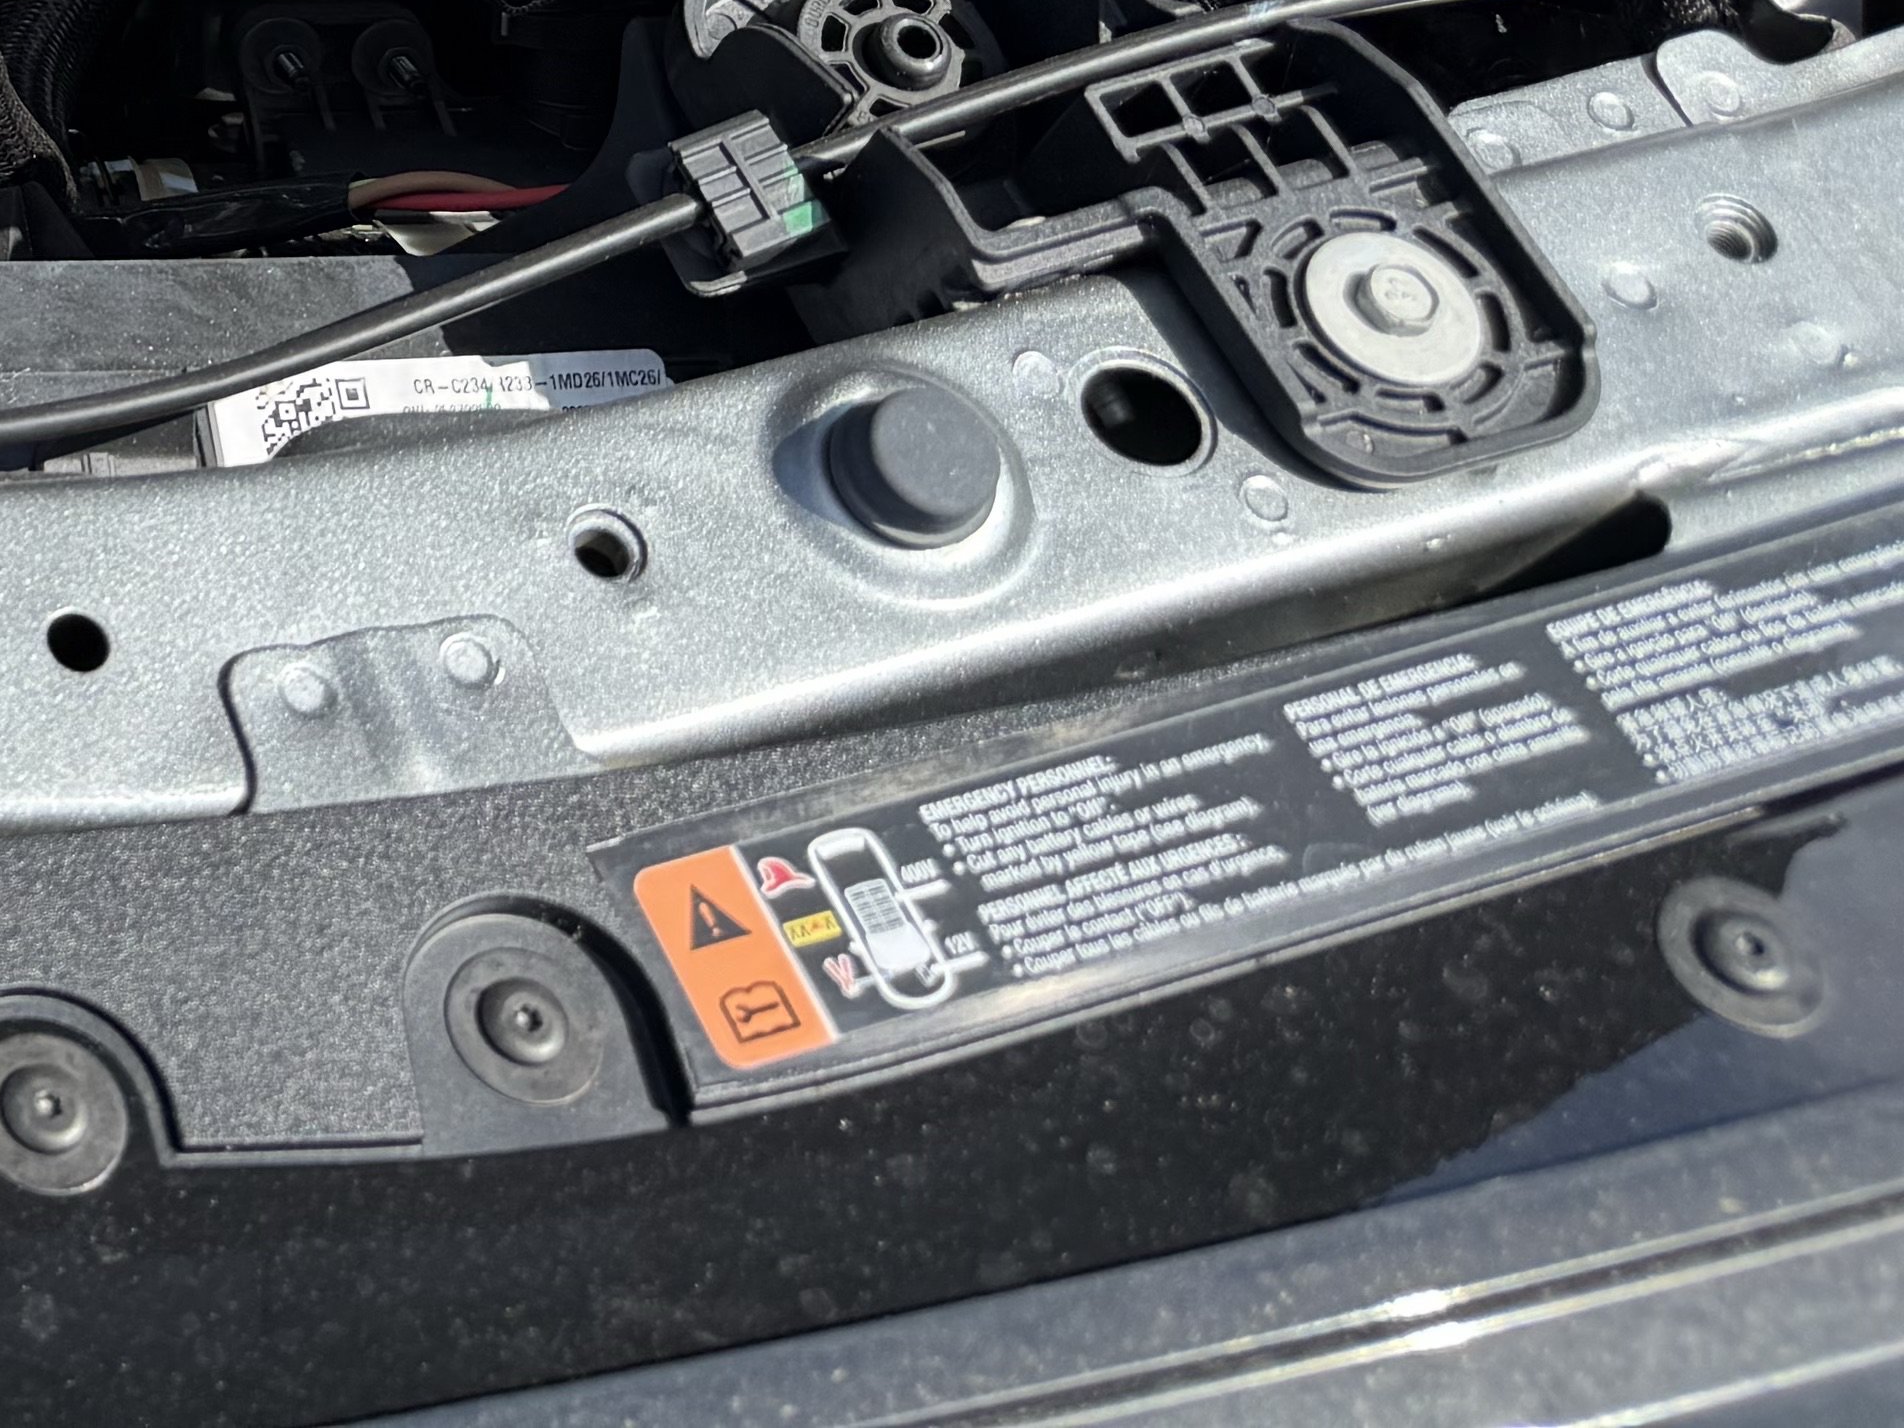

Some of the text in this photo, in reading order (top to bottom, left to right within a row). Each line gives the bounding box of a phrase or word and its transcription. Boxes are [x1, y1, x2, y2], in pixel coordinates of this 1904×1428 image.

[1281, 650, 1481, 722] PERSONAL DE EMERGENCIA:
[916, 753, 1120, 825] EMERGENCY PERSONNEL:
[929, 820, 953, 842] To
[949, 809, 988, 836] help
[985, 797, 1031, 824] avoid
[1029, 779, 1098, 814] personal
[1093, 766, 1143, 797] injury
[1180, 731, 1276, 773] emergency,
[953, 830, 993, 856] Turn
[990, 813, 1053, 846] ignition
[965, 850, 998, 874] Cut
[996, 843, 1028, 868] any
[1025, 826, 1085, 859] battery
[1080, 810, 1136, 840] cables
[1149, 791, 1203, 819] wires
[978, 860, 1043, 893] marked
[1061, 838, 1115, 868] yellow
[1112, 828, 1152, 855] tape
[1147, 816, 1187, 844] (see
[1182, 794, 1266, 833] diagram).
[976, 884, 1068, 924] PERSONNEL
